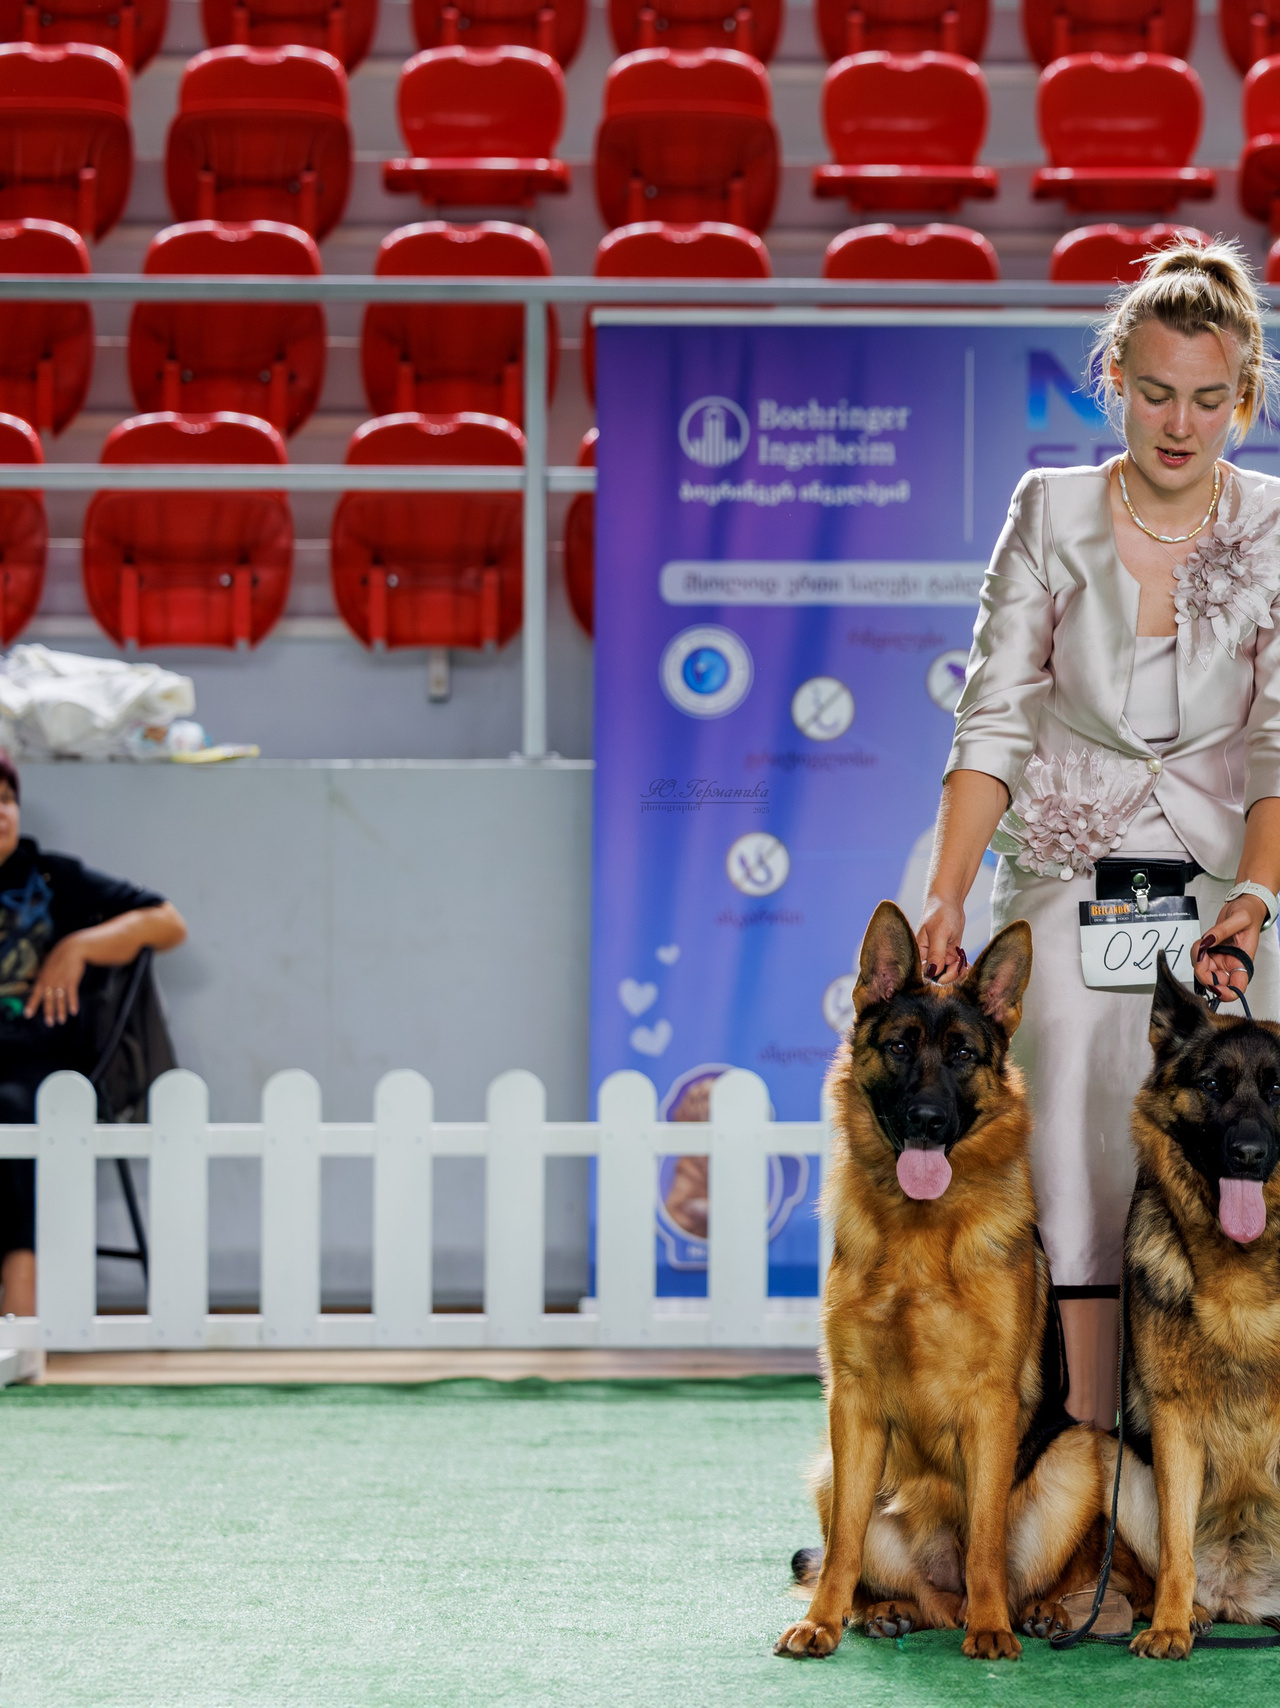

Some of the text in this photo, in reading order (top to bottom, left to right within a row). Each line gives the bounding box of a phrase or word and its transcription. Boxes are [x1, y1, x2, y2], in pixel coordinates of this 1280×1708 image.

[758, 399, 911, 436] Boehringer
[758, 435, 897, 471] Ingelheim
[1091, 903, 1130, 917] BELCANDO
[1104, 927, 1184, 971] 024
